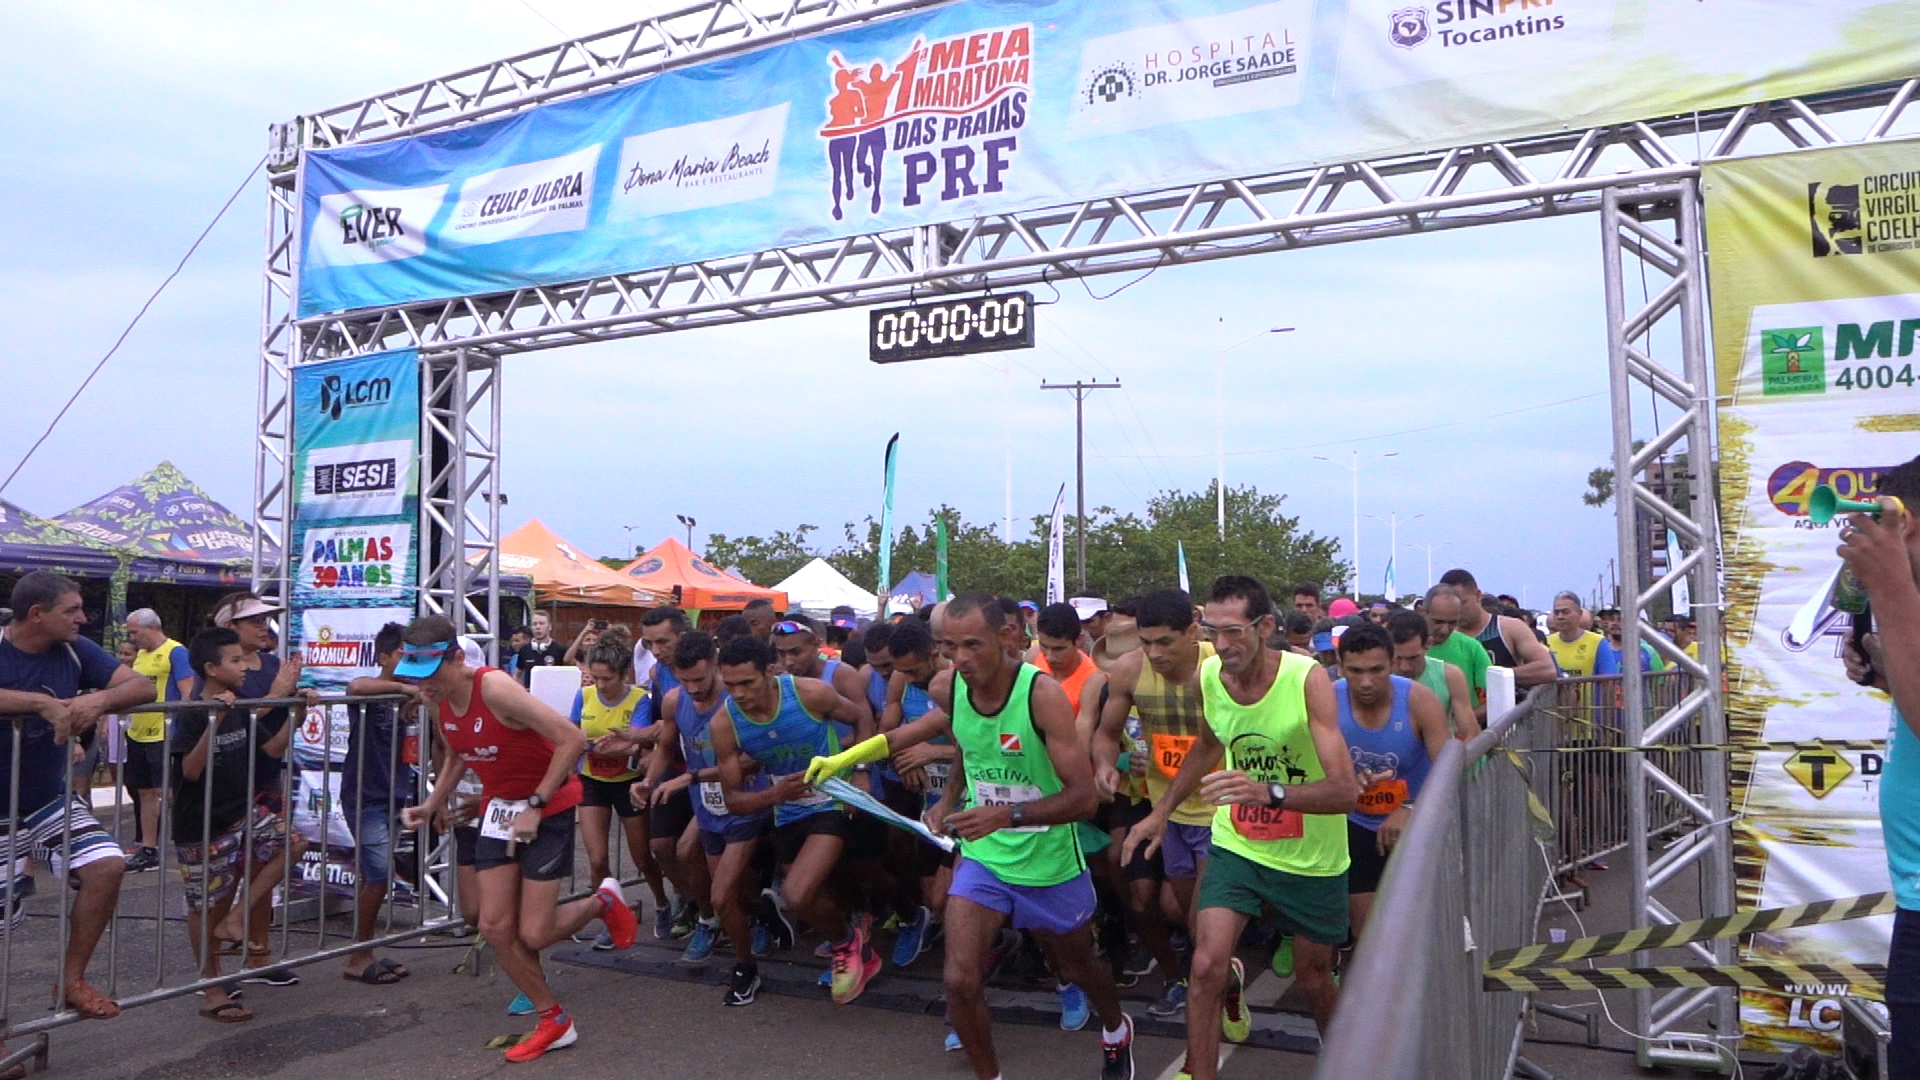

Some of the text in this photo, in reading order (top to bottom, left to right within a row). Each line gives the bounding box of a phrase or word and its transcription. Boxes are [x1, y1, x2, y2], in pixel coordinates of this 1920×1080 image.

[1436, 0, 1552, 24] SIN
[1438, 15, 1564, 47] Tocantins
[928, 27, 1029, 73] MEIA
[1145, 28, 1294, 69] HOSPITAL
[1145, 71, 1172, 87] DR.
[1177, 59, 1231, 81] JORGE
[1236, 48, 1295, 71] SAADE
[914, 58, 1029, 108] MARATONA
[893, 91, 1027, 150] DAS PRAIAS
[624, 138, 769, 194] Dona Maria Beach
[903, 136, 1015, 206] PRF
[343, 206, 404, 244] EVER
[877, 298, 1024, 349] 00:00:00
[341, 463, 389, 489] SESI
[312, 536, 393, 563] PALMAS
[313, 564, 393, 588] 30 ANOS
[360, 641, 378, 667] M
[1163, 751, 1182, 768] 02
[1237, 803, 1284, 825] 0362
